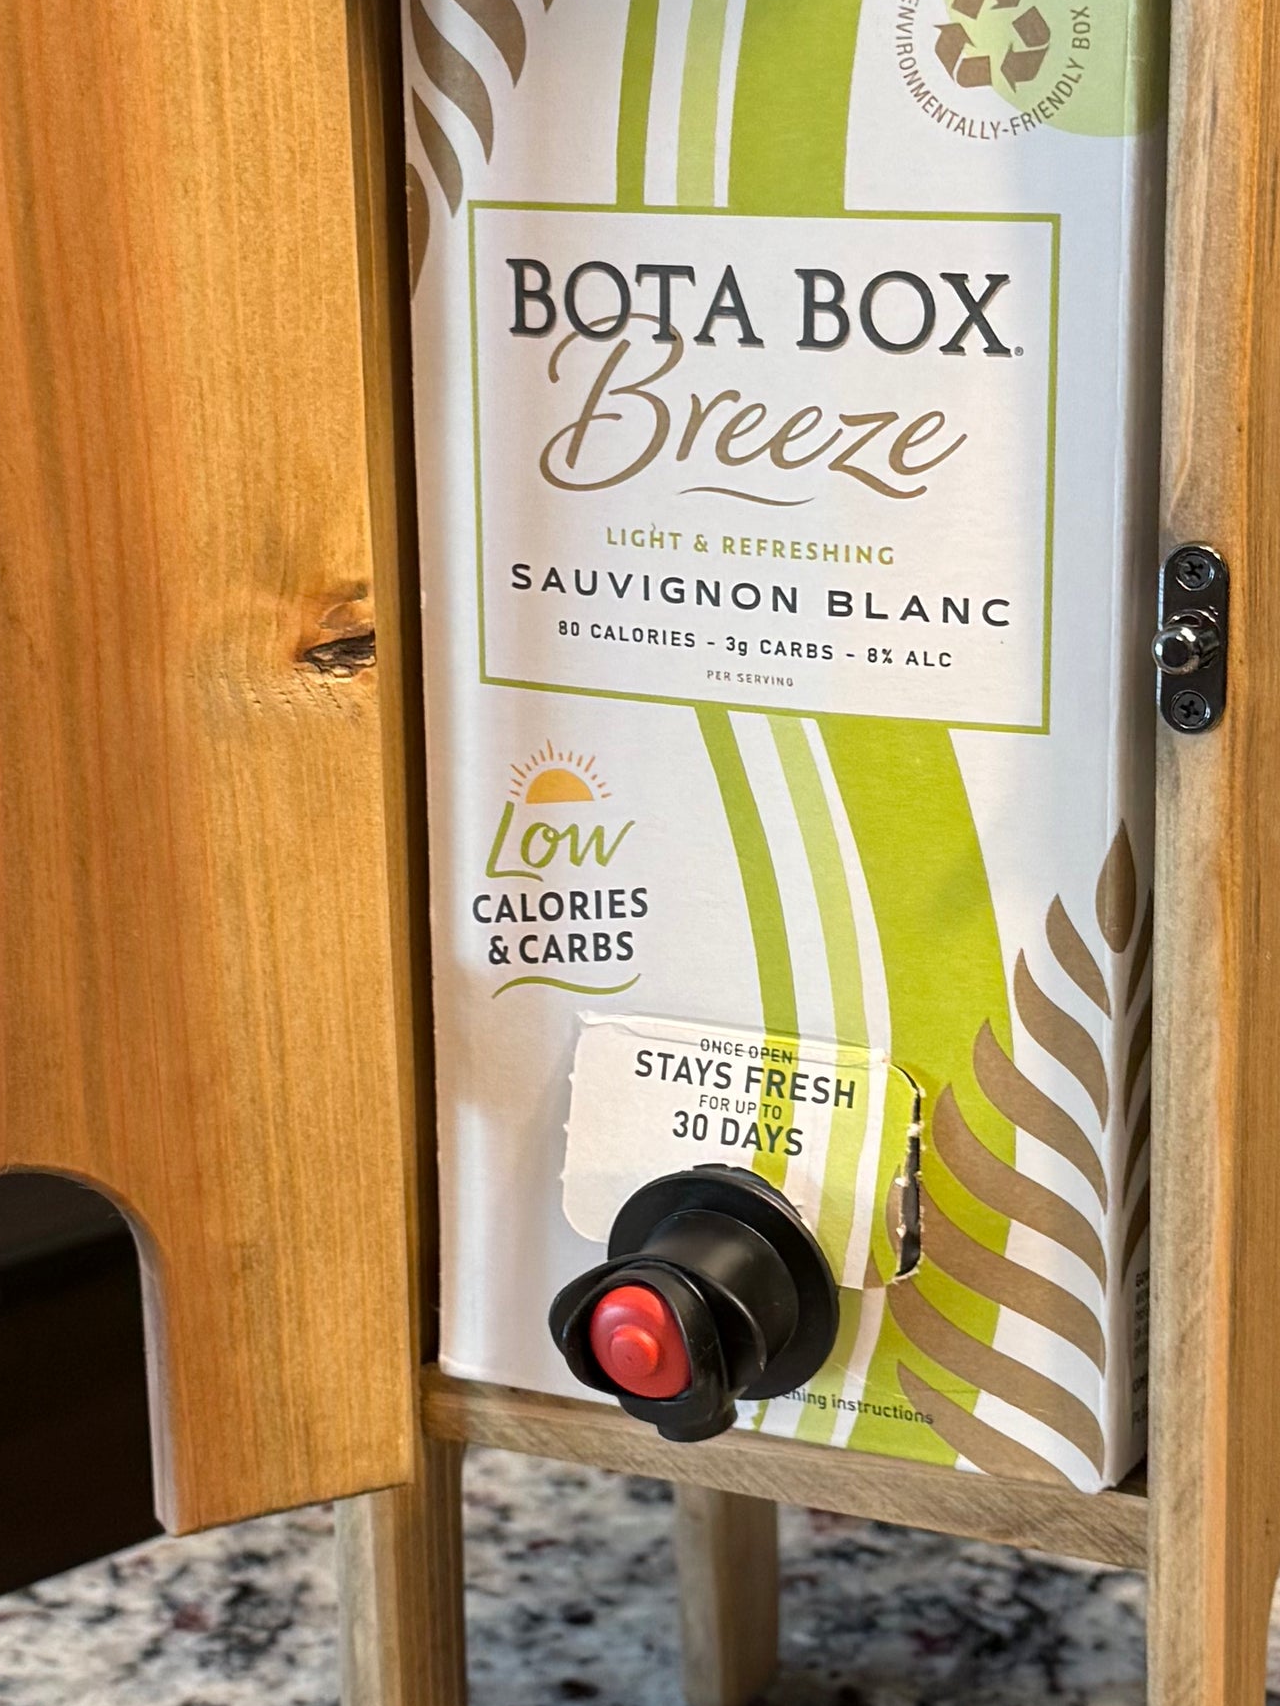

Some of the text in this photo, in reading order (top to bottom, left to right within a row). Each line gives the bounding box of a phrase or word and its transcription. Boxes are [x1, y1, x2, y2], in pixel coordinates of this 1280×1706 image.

[1070, 6, 1091, 50] BOX
[506, 258, 764, 348] BOTA
[539, 313, 967, 500] Breeze
[606, 526, 894, 565] LIGHT & REFRESHING
[511, 563, 1010, 627] SAUVIGNON BLANC
[558, 620, 580, 637] 80
[590, 623, 696, 648] CALORIES
[725, 636, 748, 656] 3g
[759, 639, 834, 660] CARBS
[867, 648, 893, 664] 8%
[905, 650, 952, 668] ALC
[706, 669, 795, 687] PER SERVING
[485, 800, 636, 882] Low
[472, 887, 649, 924] CALORIES
[488, 931, 634, 965] & CARBS
[700, 1038, 793, 1064] ONCE OPEN
[634, 1049, 856, 1109] STAYS FRESH
[699, 1094, 783, 1120] FOR UP TO
[672, 1110, 804, 1156] 30 DAYS
[831, 1394, 935, 1425] instructions
